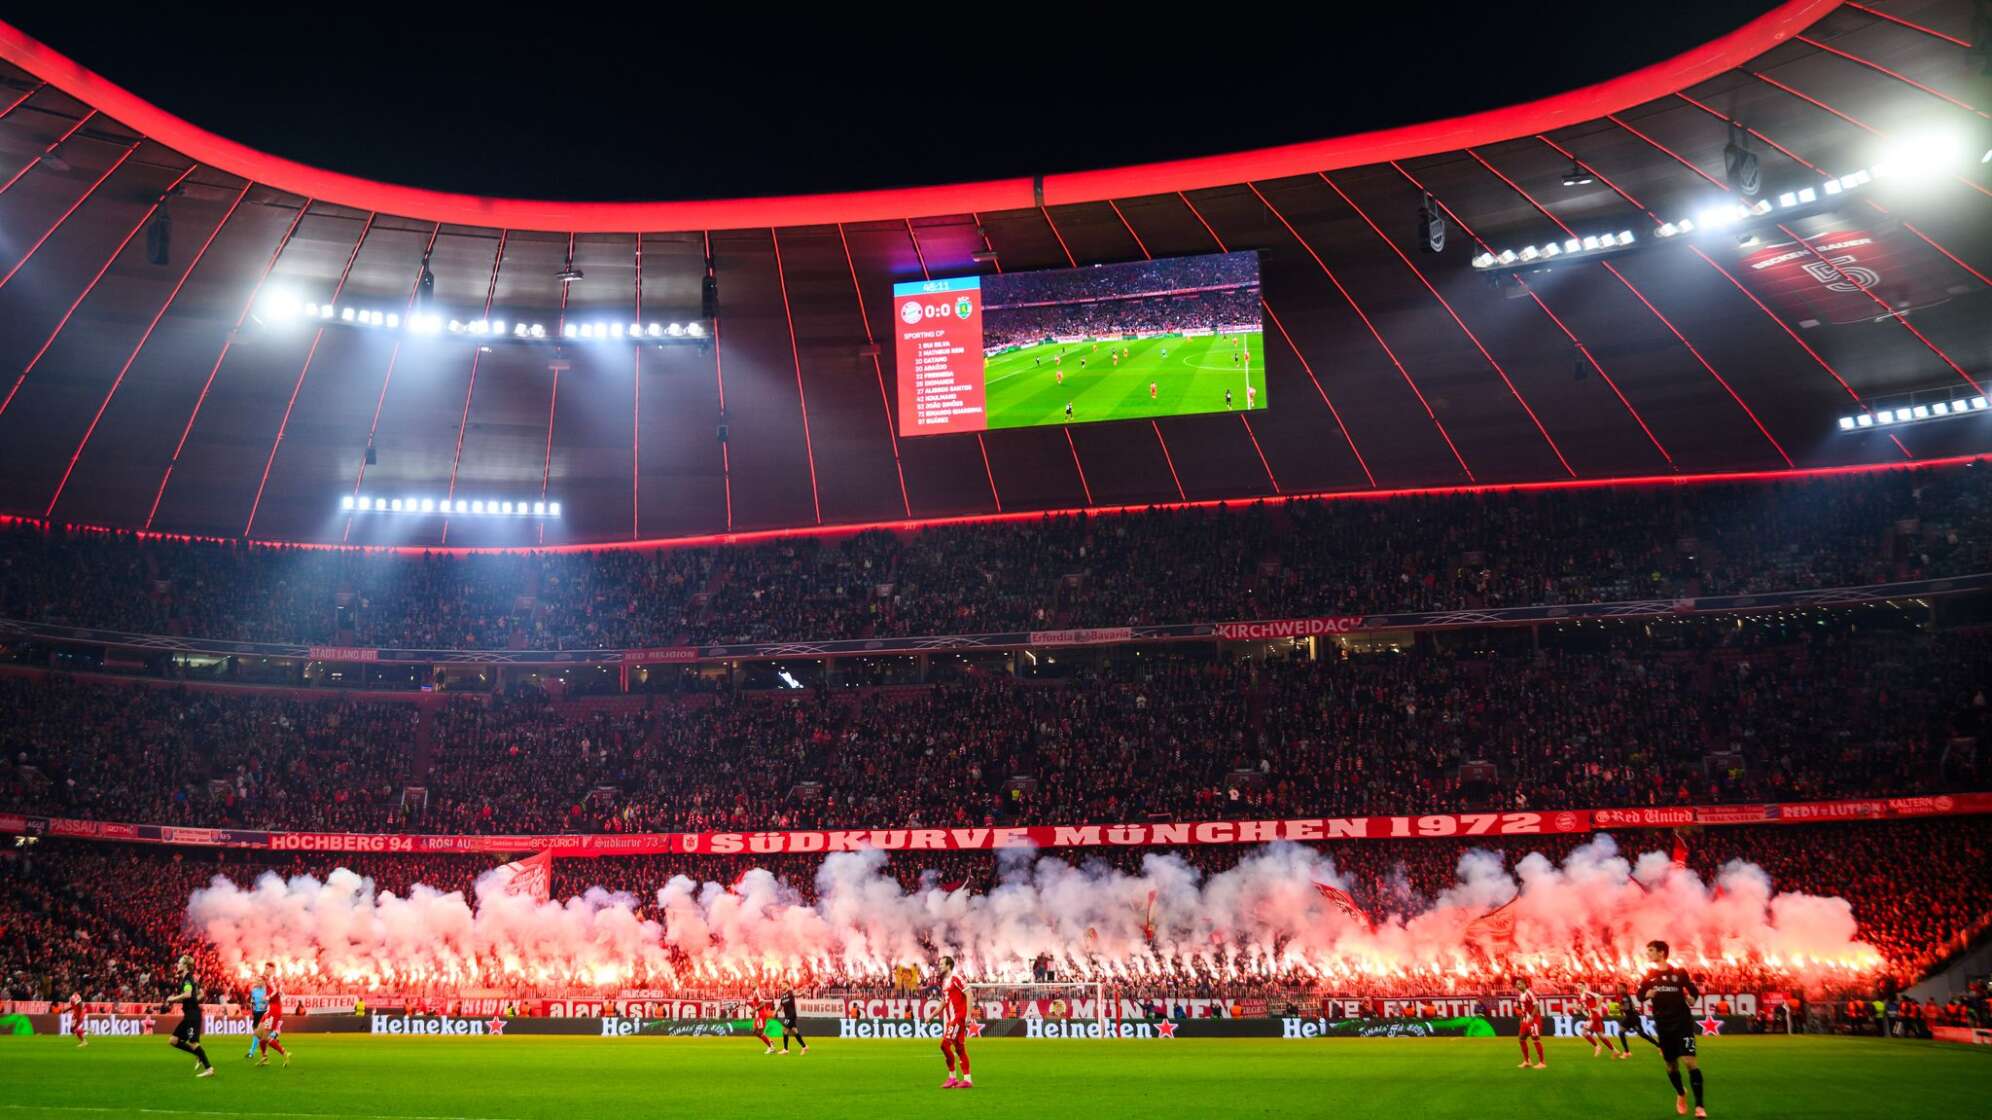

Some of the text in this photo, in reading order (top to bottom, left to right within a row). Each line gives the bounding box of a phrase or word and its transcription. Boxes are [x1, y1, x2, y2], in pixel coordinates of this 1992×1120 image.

[1801, 254, 1880, 292] 5
[924, 304, 951, 319] 0:0
[904, 331, 935, 340] SPORTING
[1091, 630, 1129, 640] Bavaria
[1612, 810, 1640, 822] Red
[1644, 808, 1693, 822] United
[50, 818, 97, 833] PASSAU
[710, 813, 1542, 854] SÜDKURVE MÜNCHEN 1972
[272, 832, 384, 850] HÖCHBERG
[305, 997, 354, 1008] BRETTEN
[60, 1012, 140, 1035] Hineken
[371, 1014, 484, 1034] Heineken
[840, 1018, 944, 1038] Heineke
[1026, 1018, 1152, 1038] Heineken
